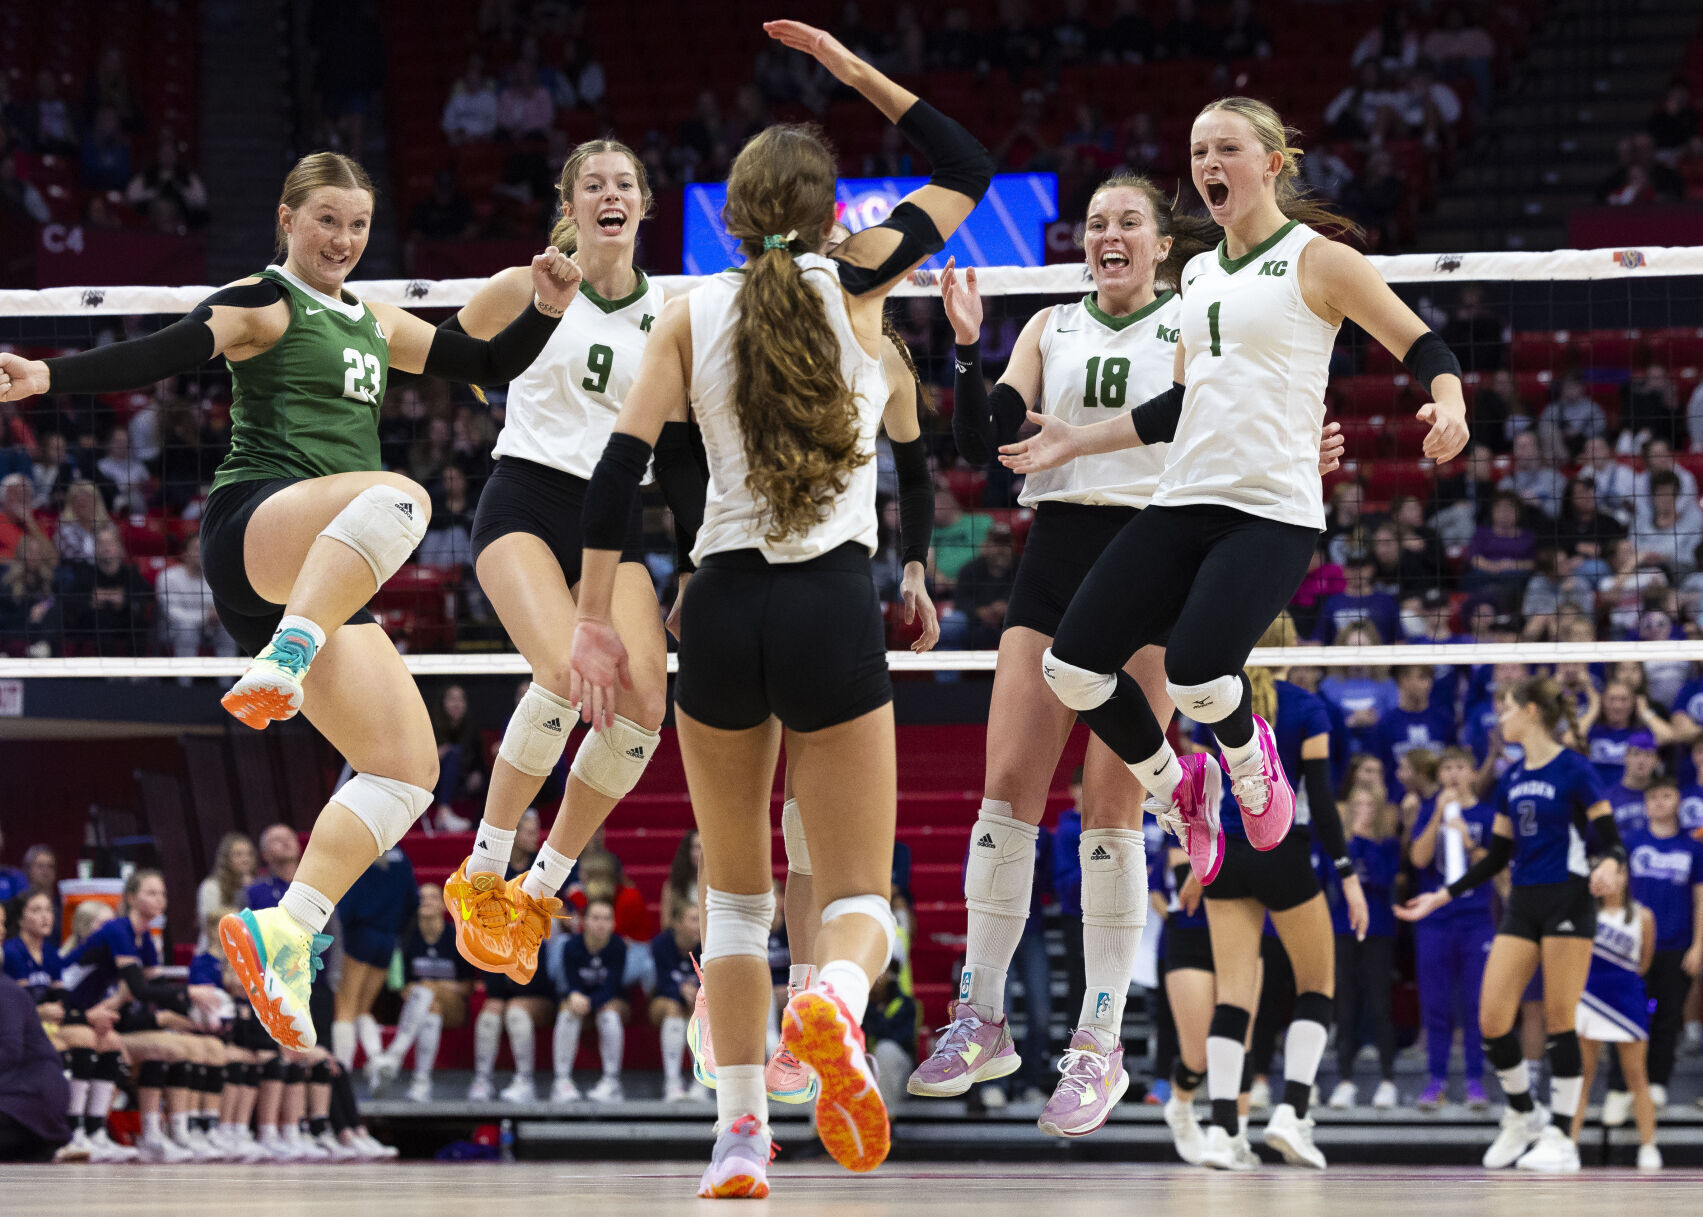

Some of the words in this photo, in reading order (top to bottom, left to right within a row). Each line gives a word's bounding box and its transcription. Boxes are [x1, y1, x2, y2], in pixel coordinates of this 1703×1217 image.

[43, 224, 84, 255] C4
[1257, 260, 1289, 277] KC
[1155, 323, 1181, 343] KC
[1207, 301, 1222, 357] 1
[342, 347, 381, 404] 23
[582, 343, 614, 394] 9
[1083, 356, 1131, 408] 18
[394, 503, 413, 521] adidas
[542, 722, 562, 733] adidas
[625, 750, 645, 760] adidas
[1516, 799, 1538, 837] 2
[976, 841, 996, 849] adidas
